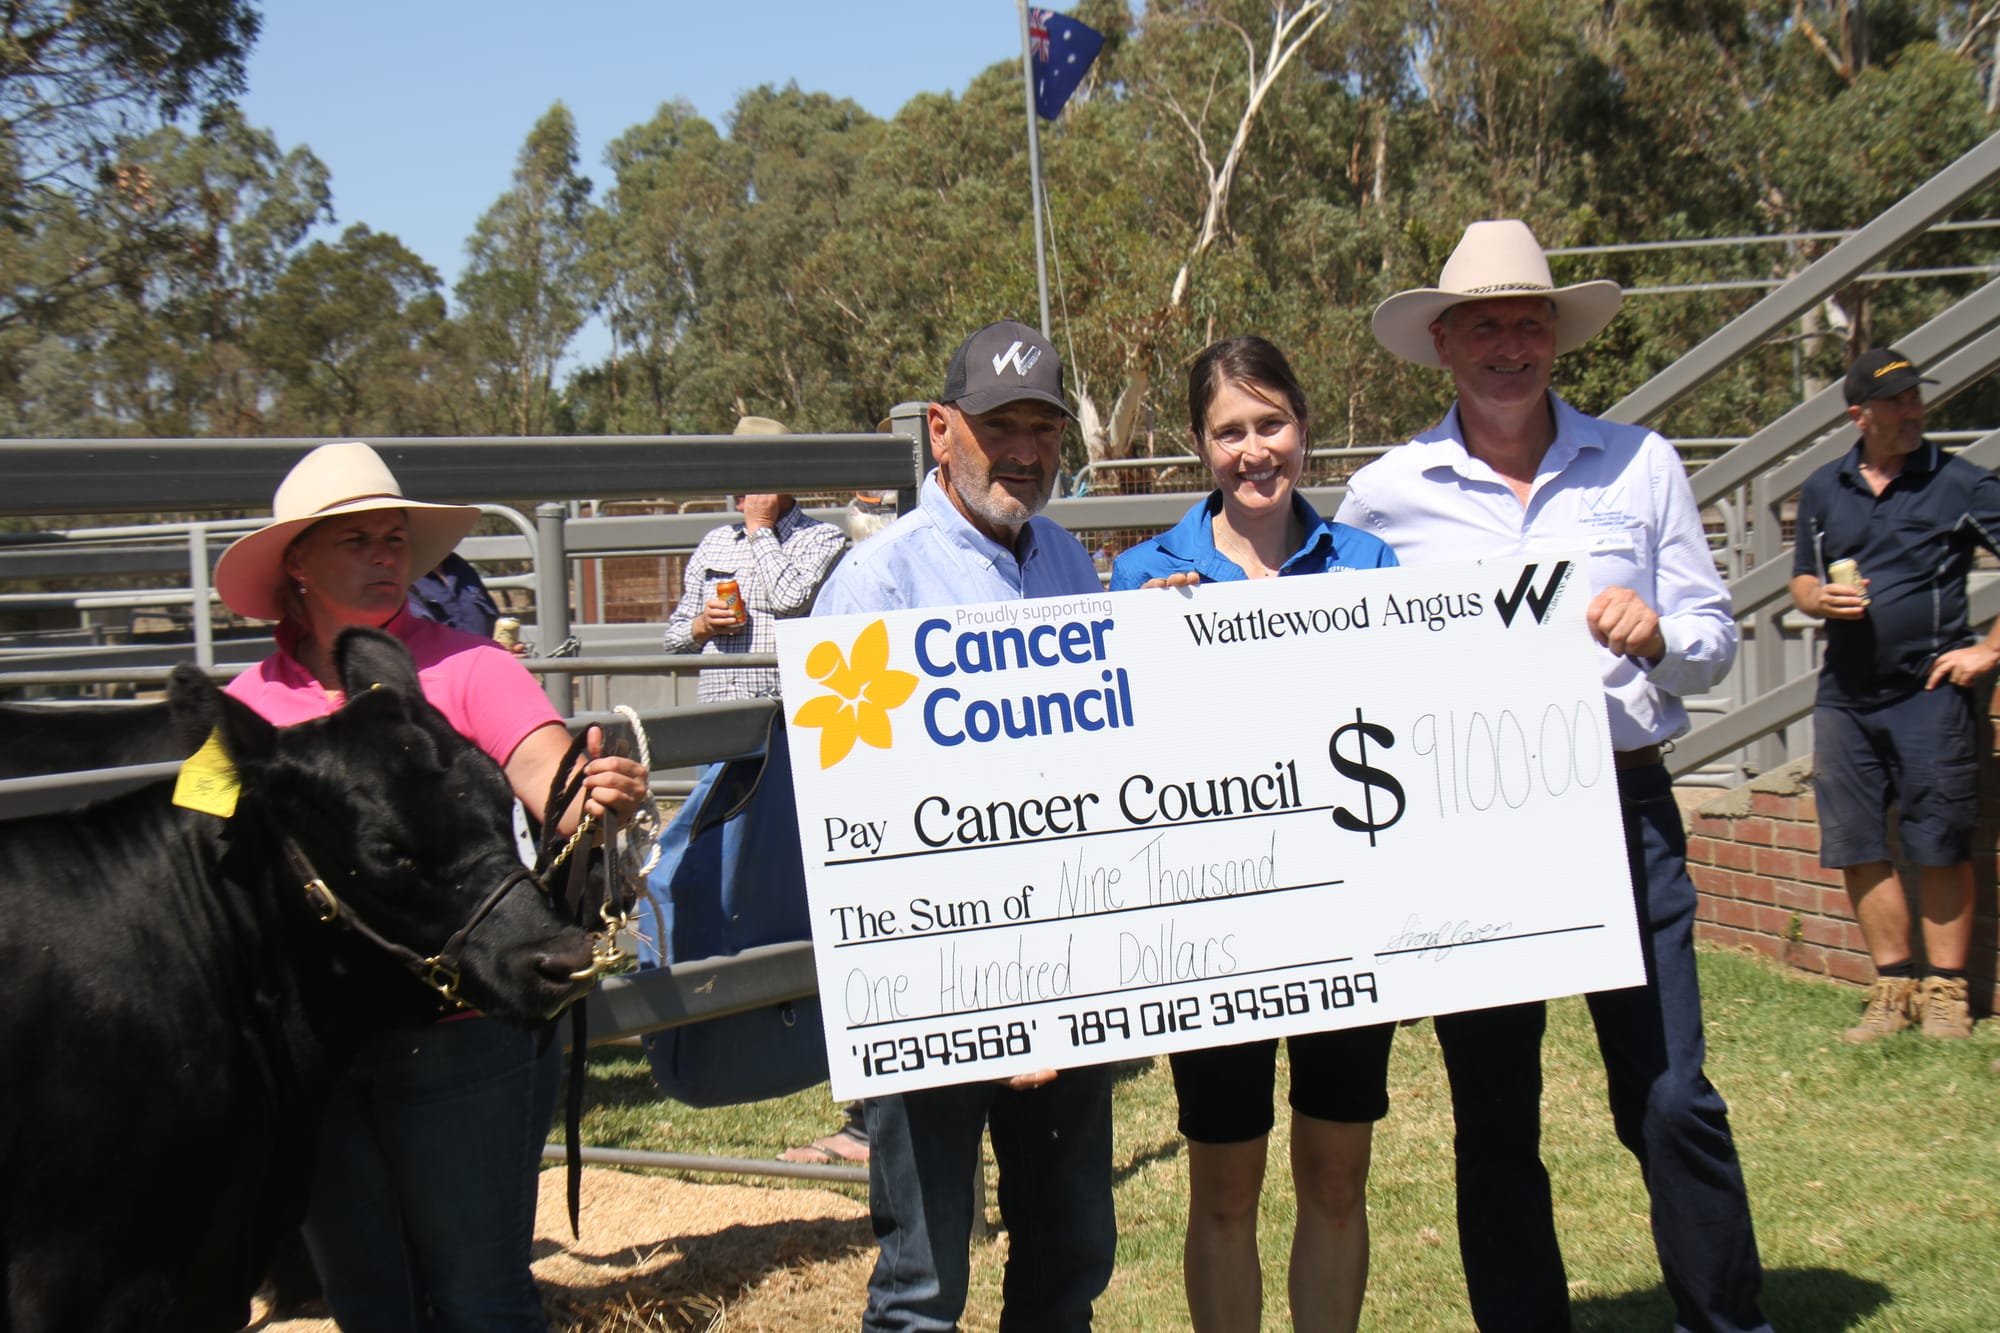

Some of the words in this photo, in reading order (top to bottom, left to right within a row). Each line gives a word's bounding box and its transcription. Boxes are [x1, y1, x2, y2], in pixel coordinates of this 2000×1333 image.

[956, 605, 1019, 627] Proudly
[1022, 598, 1113, 623] supporting
[1184, 597, 1370, 646] Wattlewood
[1382, 592, 1483, 632] Angus
[915, 619, 1114, 677] Cancer
[924, 668, 1133, 746] Council
[1413, 700, 1601, 819] 9100.00
[824, 815, 887, 854] Pay
[914, 793, 1099, 847] Cancer
[1119, 760, 1302, 825] Council
[1058, 846, 1124, 918] Nine
[1130, 829, 1279, 906] Thousand
[830, 905, 896, 940] The
[909, 898, 991, 932] Sum
[1004, 885, 1034, 920] of
[846, 968, 909, 1025] One
[940, 933, 1073, 1014] Hundred
[1120, 918, 1238, 988] Dollars
[1057, 1007, 1131, 1047] 789
[1140, 996, 1202, 1036] 012
